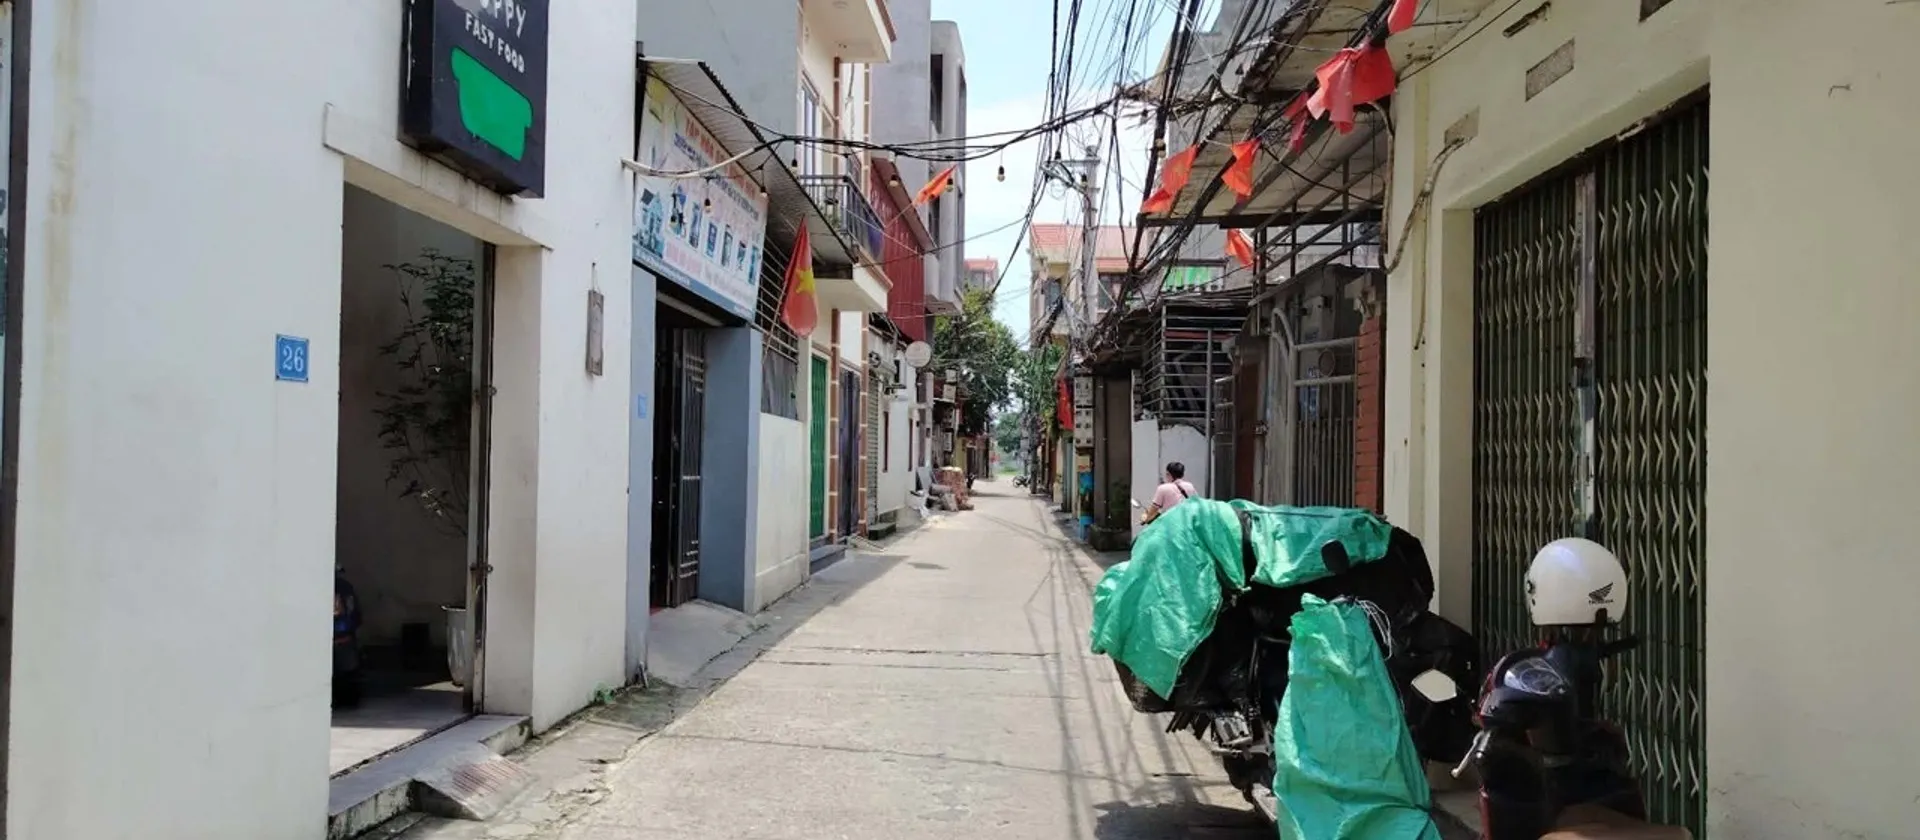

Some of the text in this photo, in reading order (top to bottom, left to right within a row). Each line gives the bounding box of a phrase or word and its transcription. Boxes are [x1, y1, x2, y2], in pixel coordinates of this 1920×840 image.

[465, 12, 525, 73] FAST FOOD
[283, 345, 304, 372] 26
